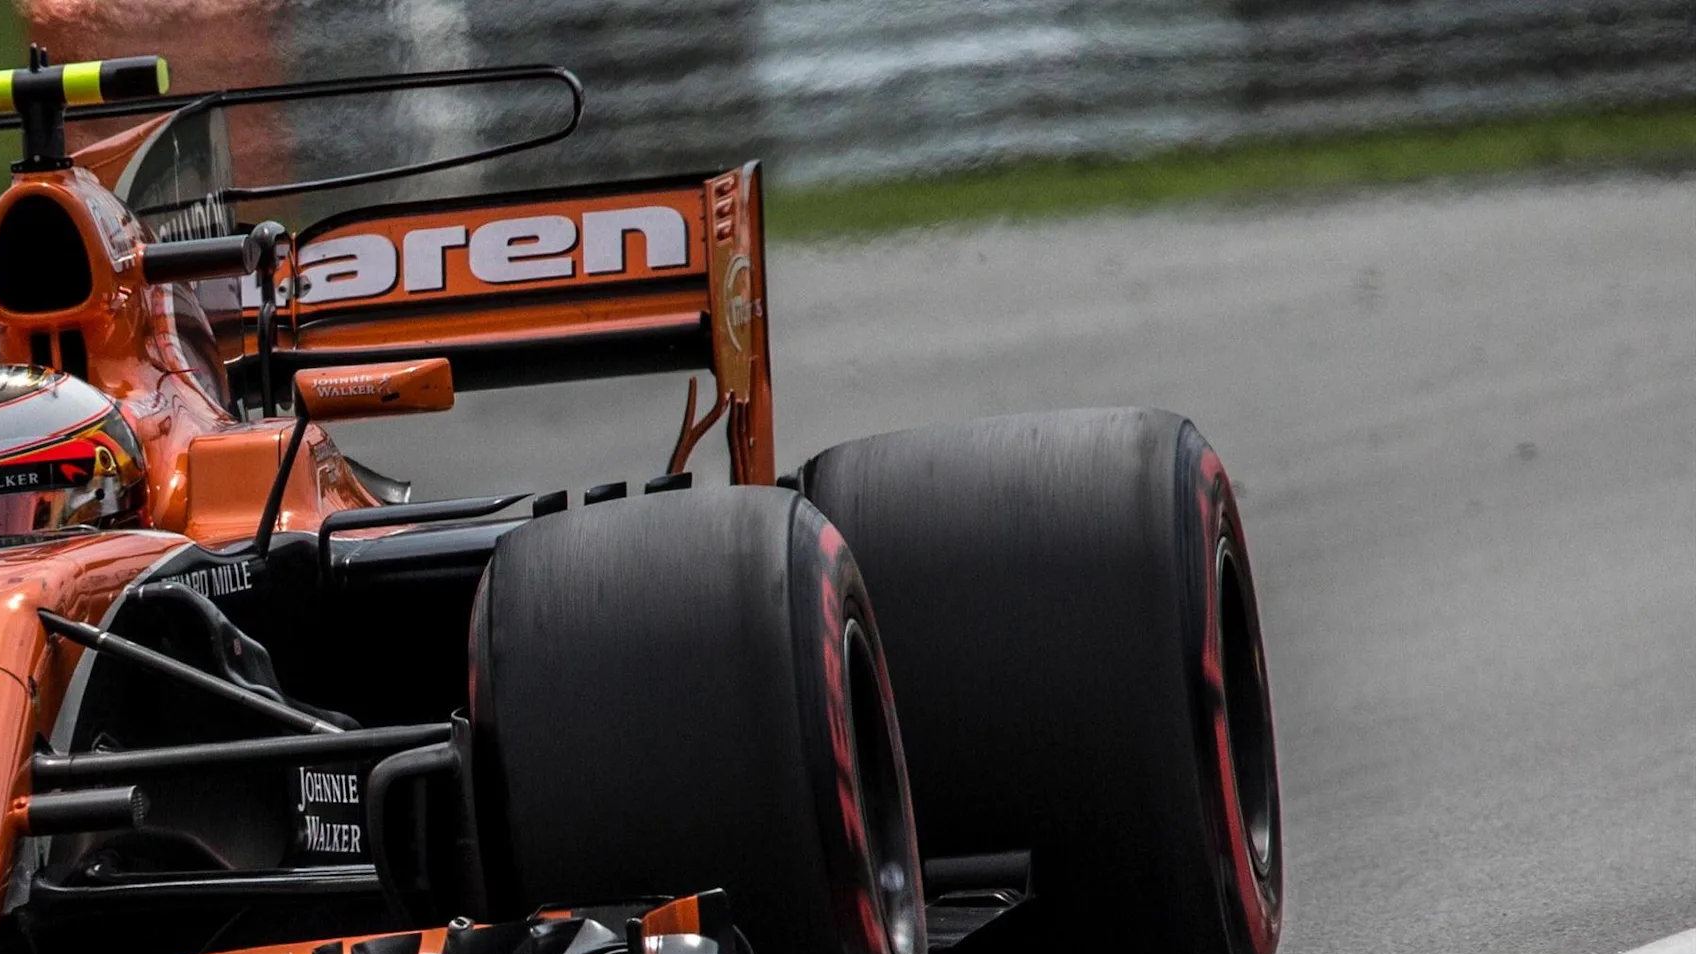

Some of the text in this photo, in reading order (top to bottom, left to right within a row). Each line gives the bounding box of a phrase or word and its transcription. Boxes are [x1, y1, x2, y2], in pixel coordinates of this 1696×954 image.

[312, 374, 373, 389] JOHNNIE
[317, 384, 375, 397] WALKER
[211, 561, 253, 597] MILLE
[297, 766, 360, 812] JOHNNIE
[304, 815, 361, 853] WALKER
